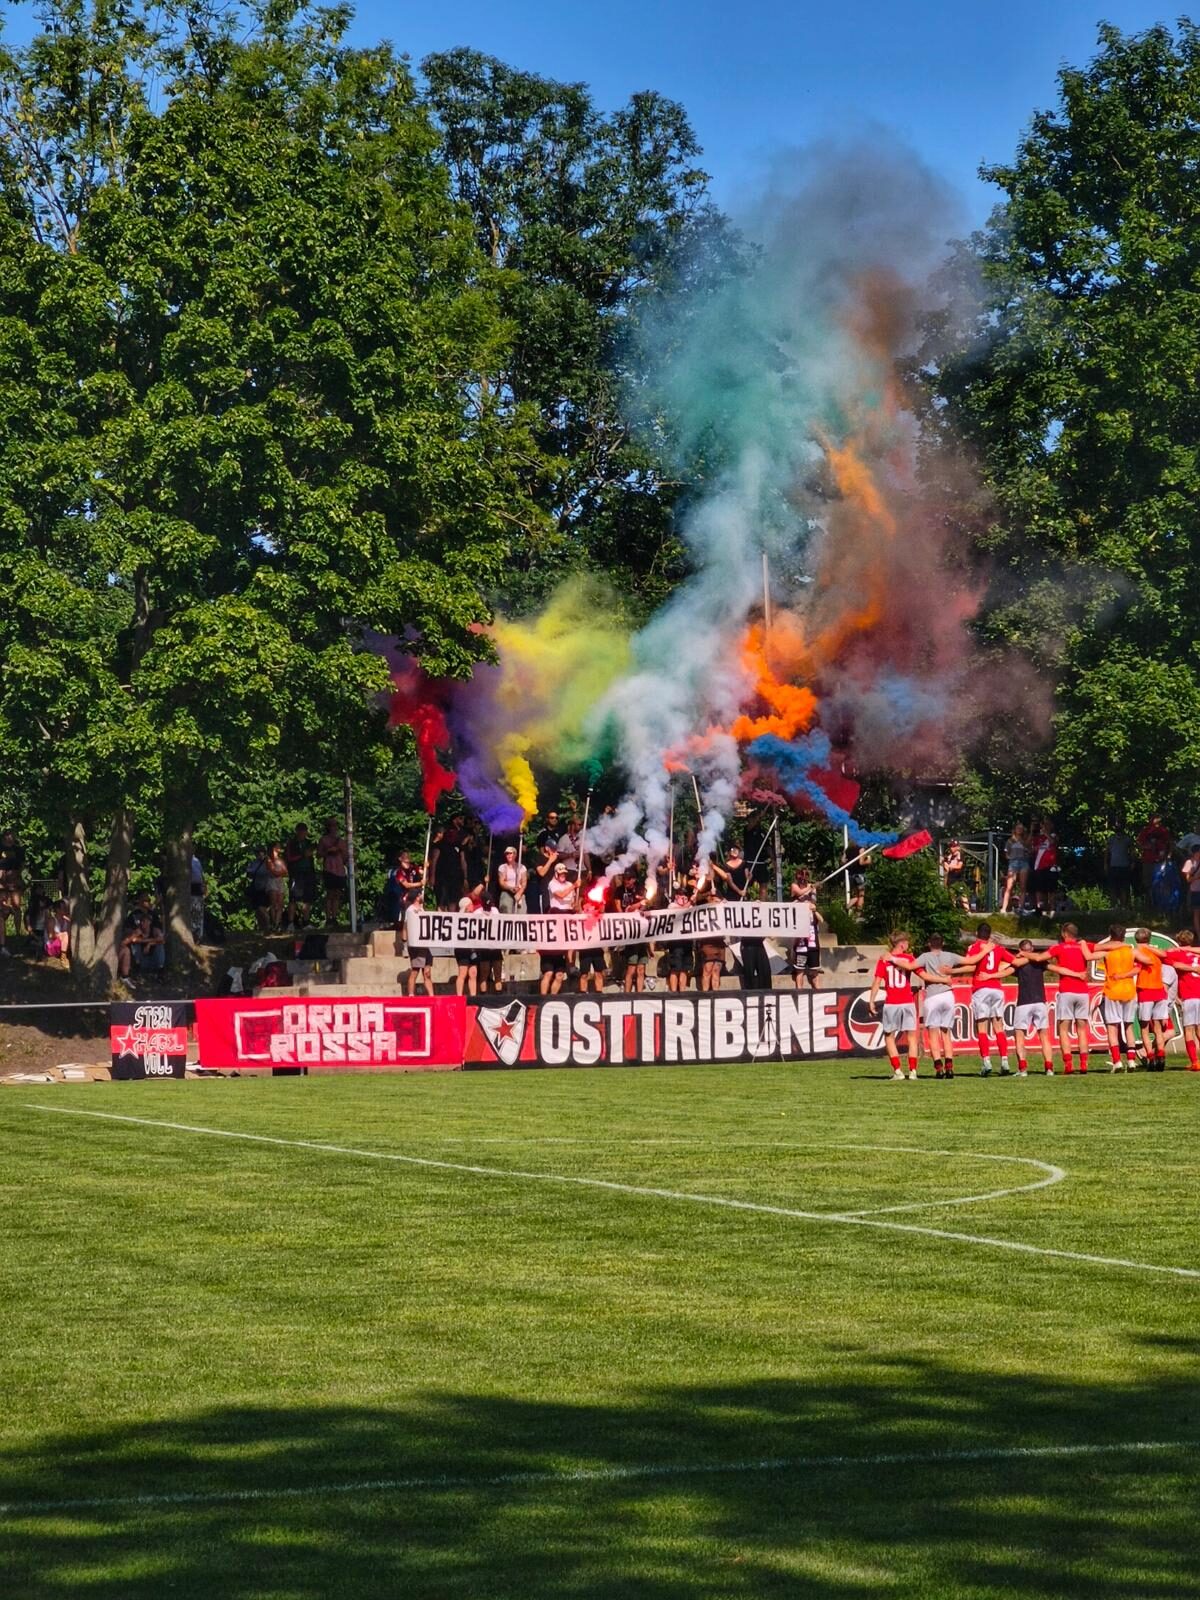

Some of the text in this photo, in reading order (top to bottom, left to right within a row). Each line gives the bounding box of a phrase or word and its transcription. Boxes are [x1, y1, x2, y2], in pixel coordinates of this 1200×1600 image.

[418, 915, 453, 941] DAS
[457, 917, 557, 942] SCHLIMMSTE
[645, 914, 676, 937] DAS
[680, 908, 721, 935] BIER
[724, 906, 762, 930] ALLE
[768, 906, 797, 929] IST!
[282, 1003, 384, 1033] ORDA
[270, 1031, 397, 1062] ROSSA
[143, 1051, 174, 1075] VOLL
